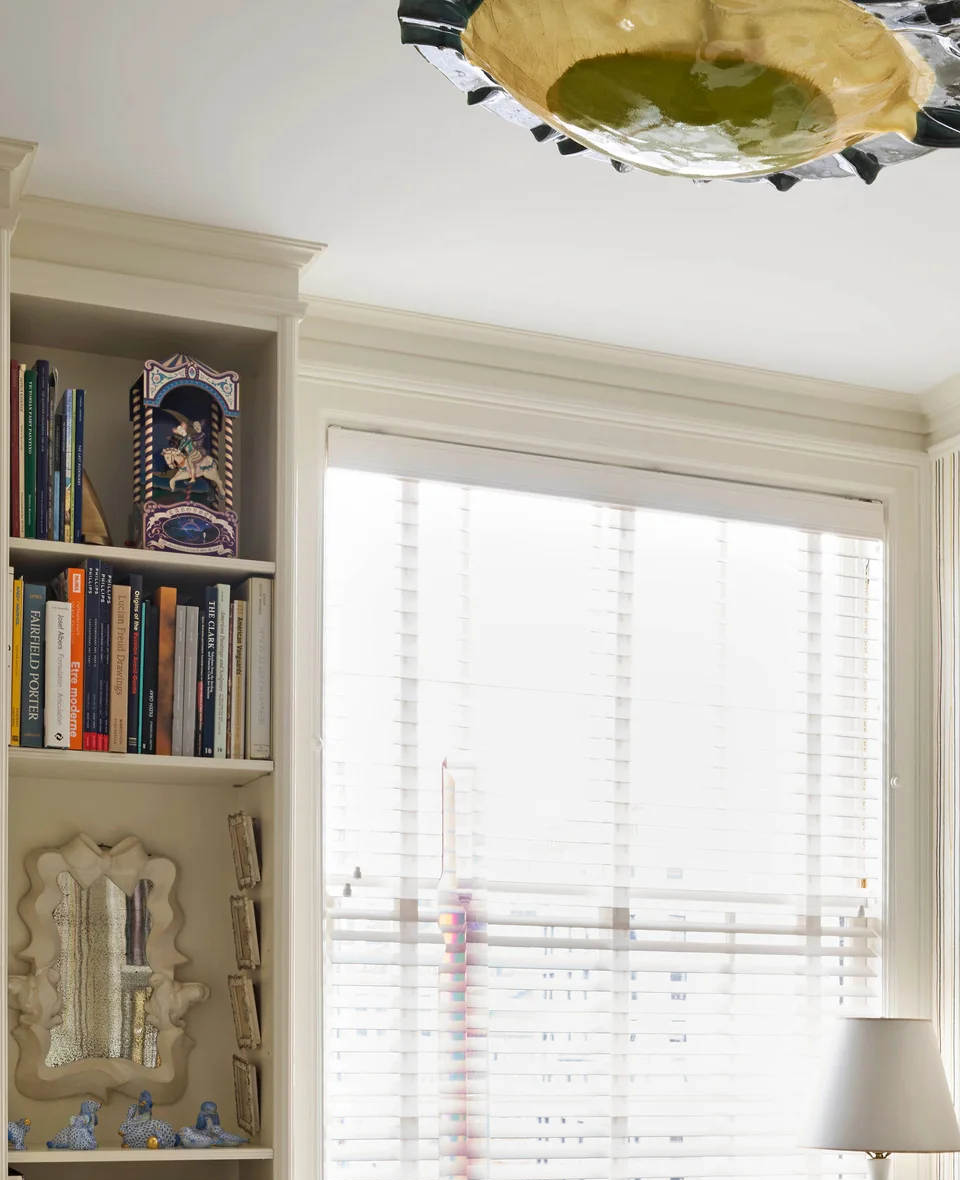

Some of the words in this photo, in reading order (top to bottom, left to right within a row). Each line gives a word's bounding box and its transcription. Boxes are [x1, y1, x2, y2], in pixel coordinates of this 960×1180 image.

[117, 595, 127, 625] Lucian
[133, 590, 141, 613] Origins
[208, 601, 216, 619] THE
[57, 614, 67, 632] Josef
[133, 613, 140, 621] of
[235, 616, 244, 644] American
[29, 610, 41, 669] FAIRFIELD
[57, 632, 67, 650] Albers
[116, 627, 126, 652] Freud
[207, 620, 216, 649] CLARK
[57, 653, 66, 687] Formulation
[114, 654, 126, 696] Drawings
[234, 645, 244, 676] Vanguards
[28, 672, 40, 721] PORTER
[56, 692, 66, 726] Articulation
[70, 687, 80, 738] moderne
